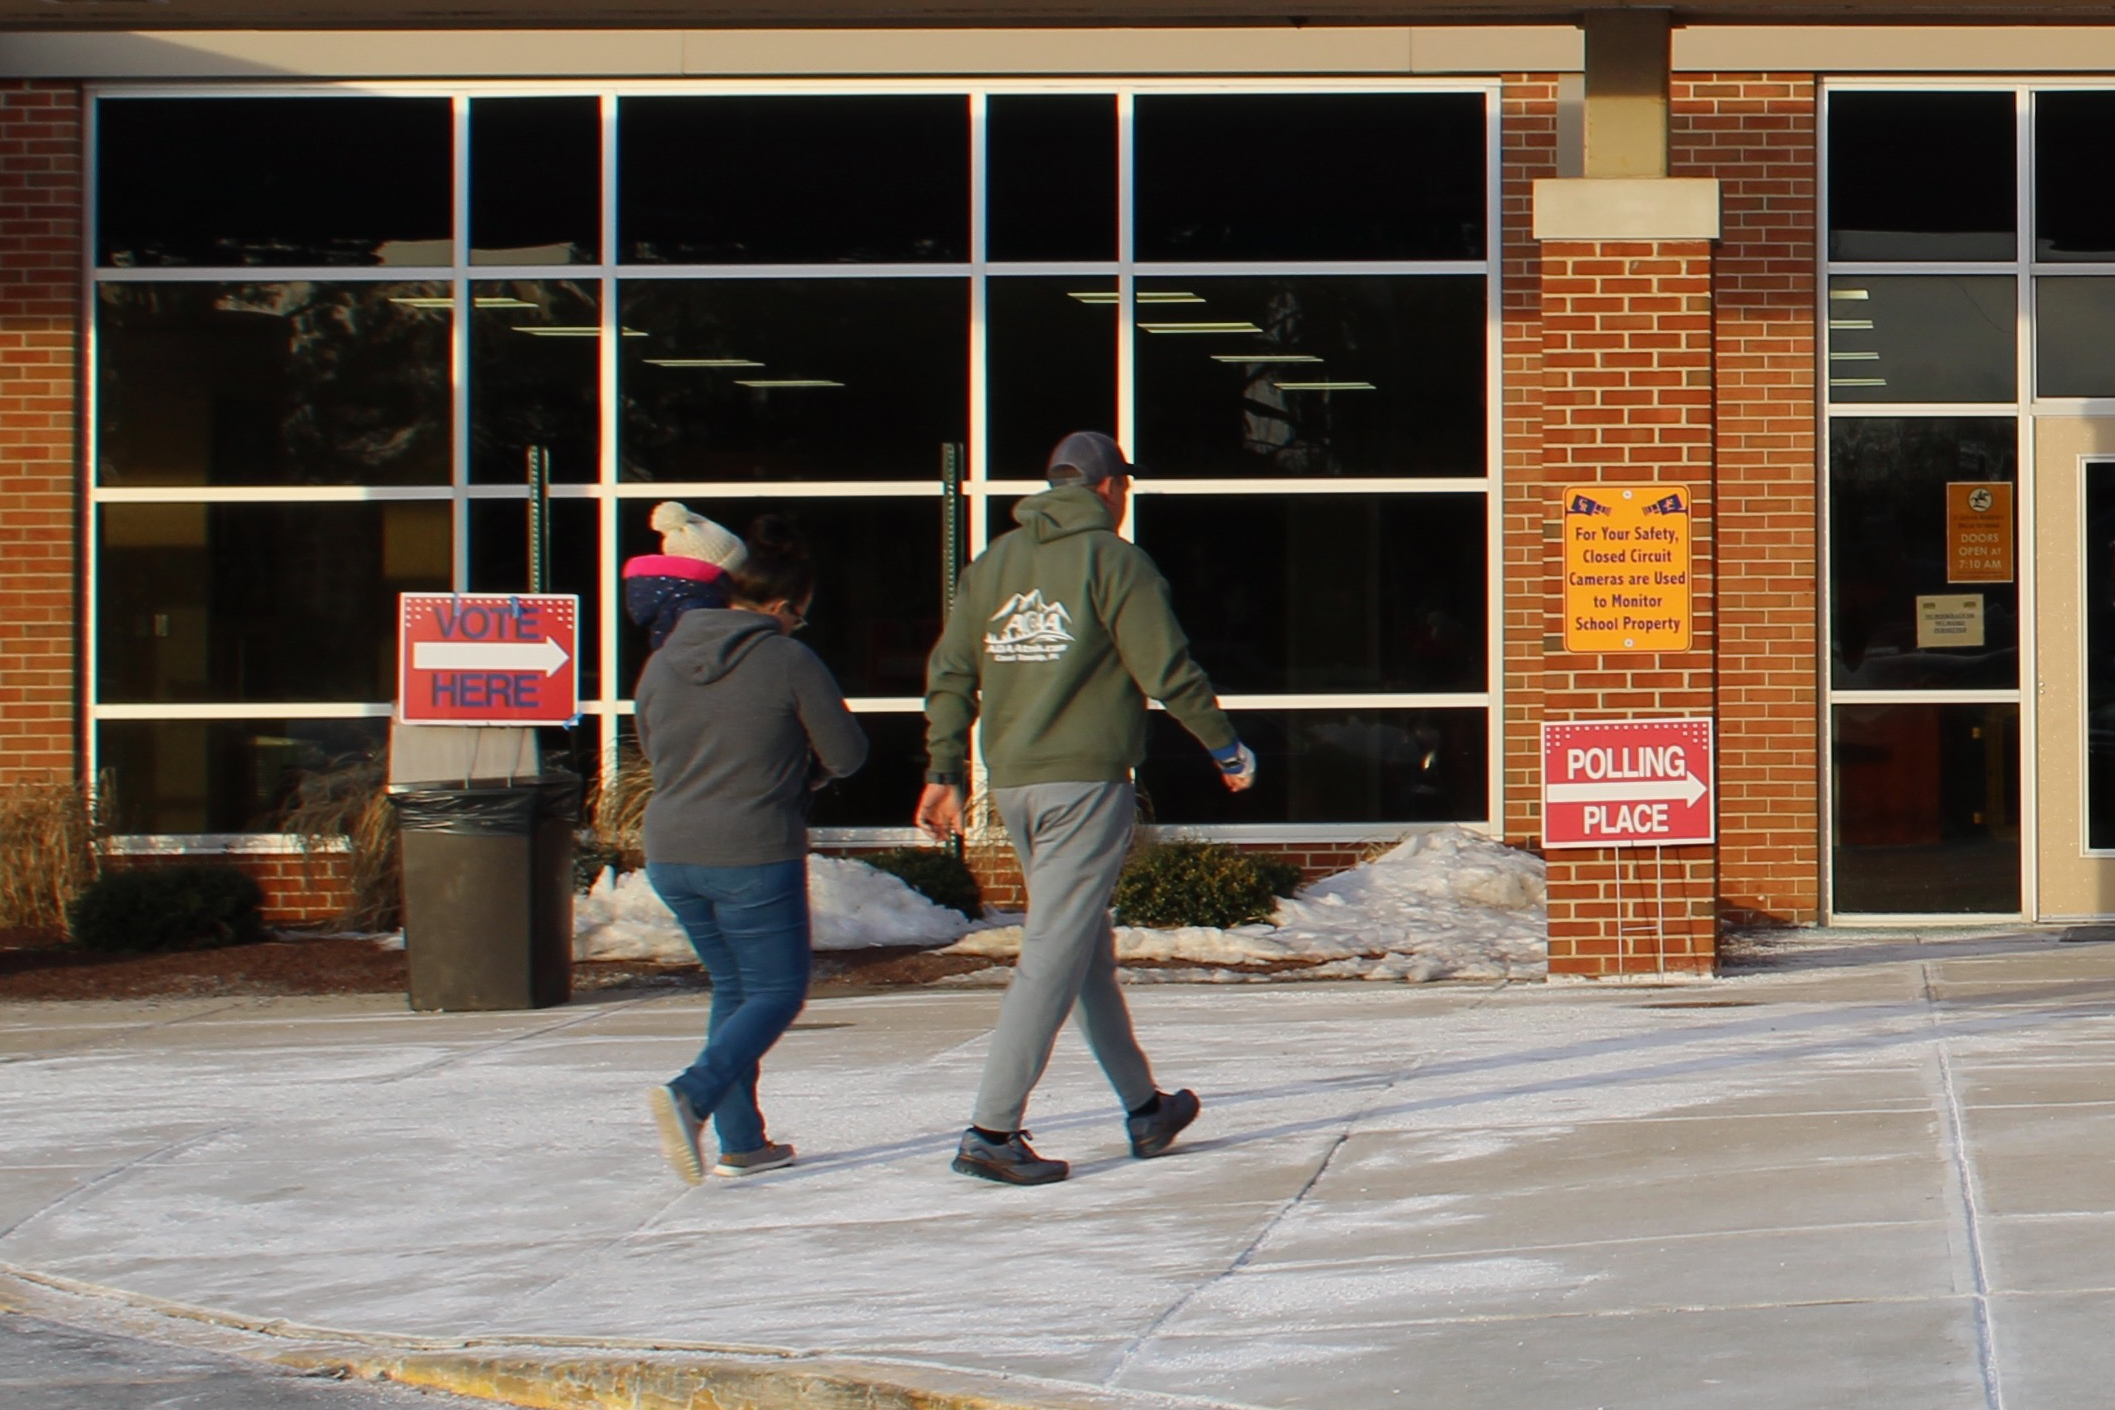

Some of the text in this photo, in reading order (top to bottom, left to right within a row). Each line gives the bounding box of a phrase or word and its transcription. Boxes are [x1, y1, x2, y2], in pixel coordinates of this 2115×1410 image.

[1575, 526, 1679, 544] For Your Safety,
[1961, 533, 2000, 543] DOORS
[1583, 548, 1673, 563] Closed Circuit
[1959, 547, 2002, 556] OPEN AT
[1960, 560, 2002, 568] 7:10 AM
[1569, 571, 1686, 586] Cameras are Used
[1594, 594, 1663, 608] to Monitor
[434, 606, 540, 639] VOTE
[1576, 616, 1681, 634] School Property
[432, 673, 540, 708] HERE
[1567, 745, 1686, 780] POLLING
[1583, 803, 1670, 835] PLACE
